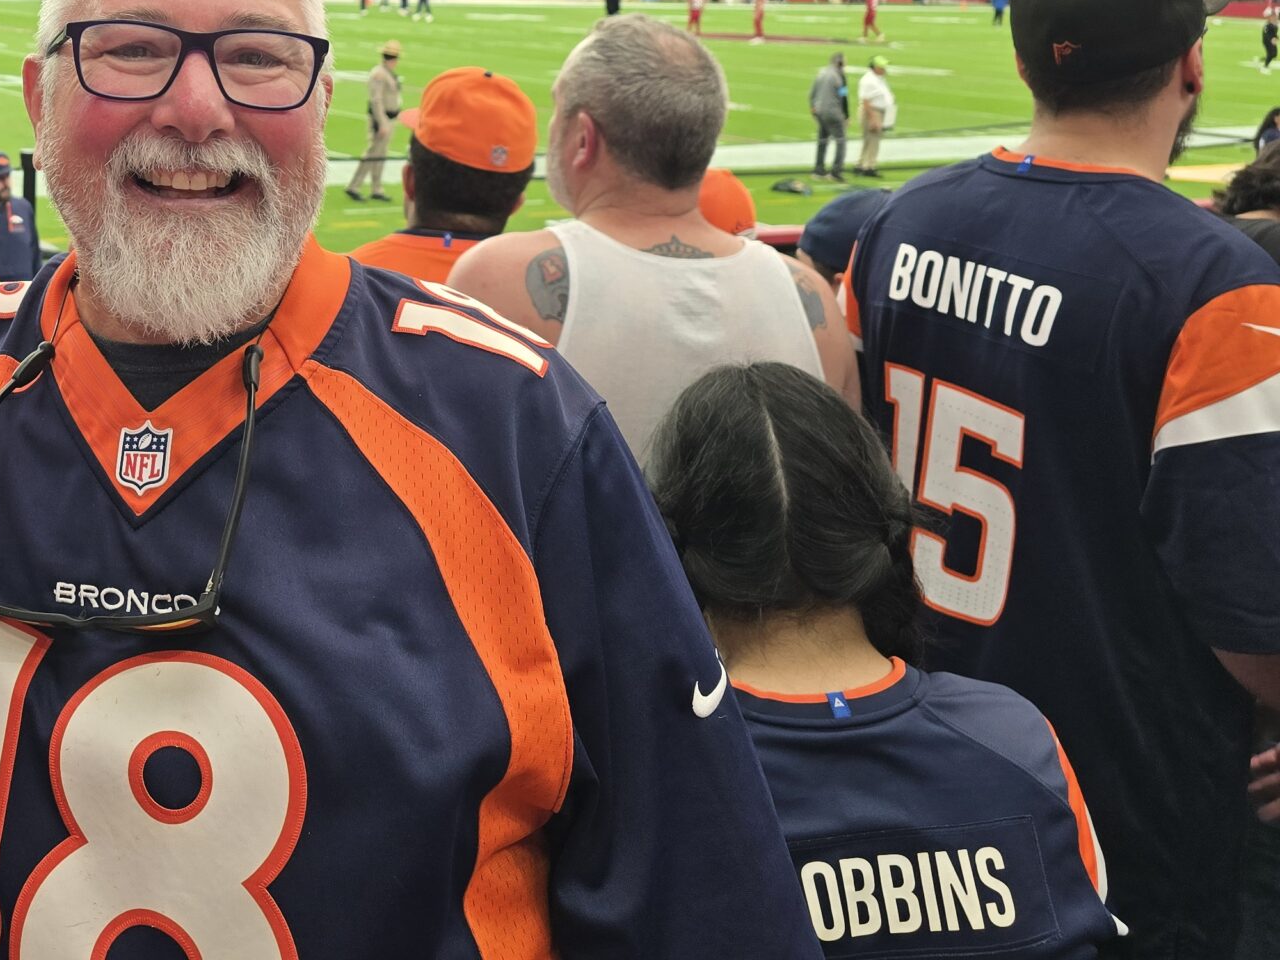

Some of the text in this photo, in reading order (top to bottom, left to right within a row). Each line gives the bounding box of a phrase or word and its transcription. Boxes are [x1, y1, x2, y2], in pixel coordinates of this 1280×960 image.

[888, 242, 1062, 347] BONITTO
[123, 452, 161, 483] NFL
[884, 360, 1025, 627] 15
[54, 581, 221, 616] BRONCO
